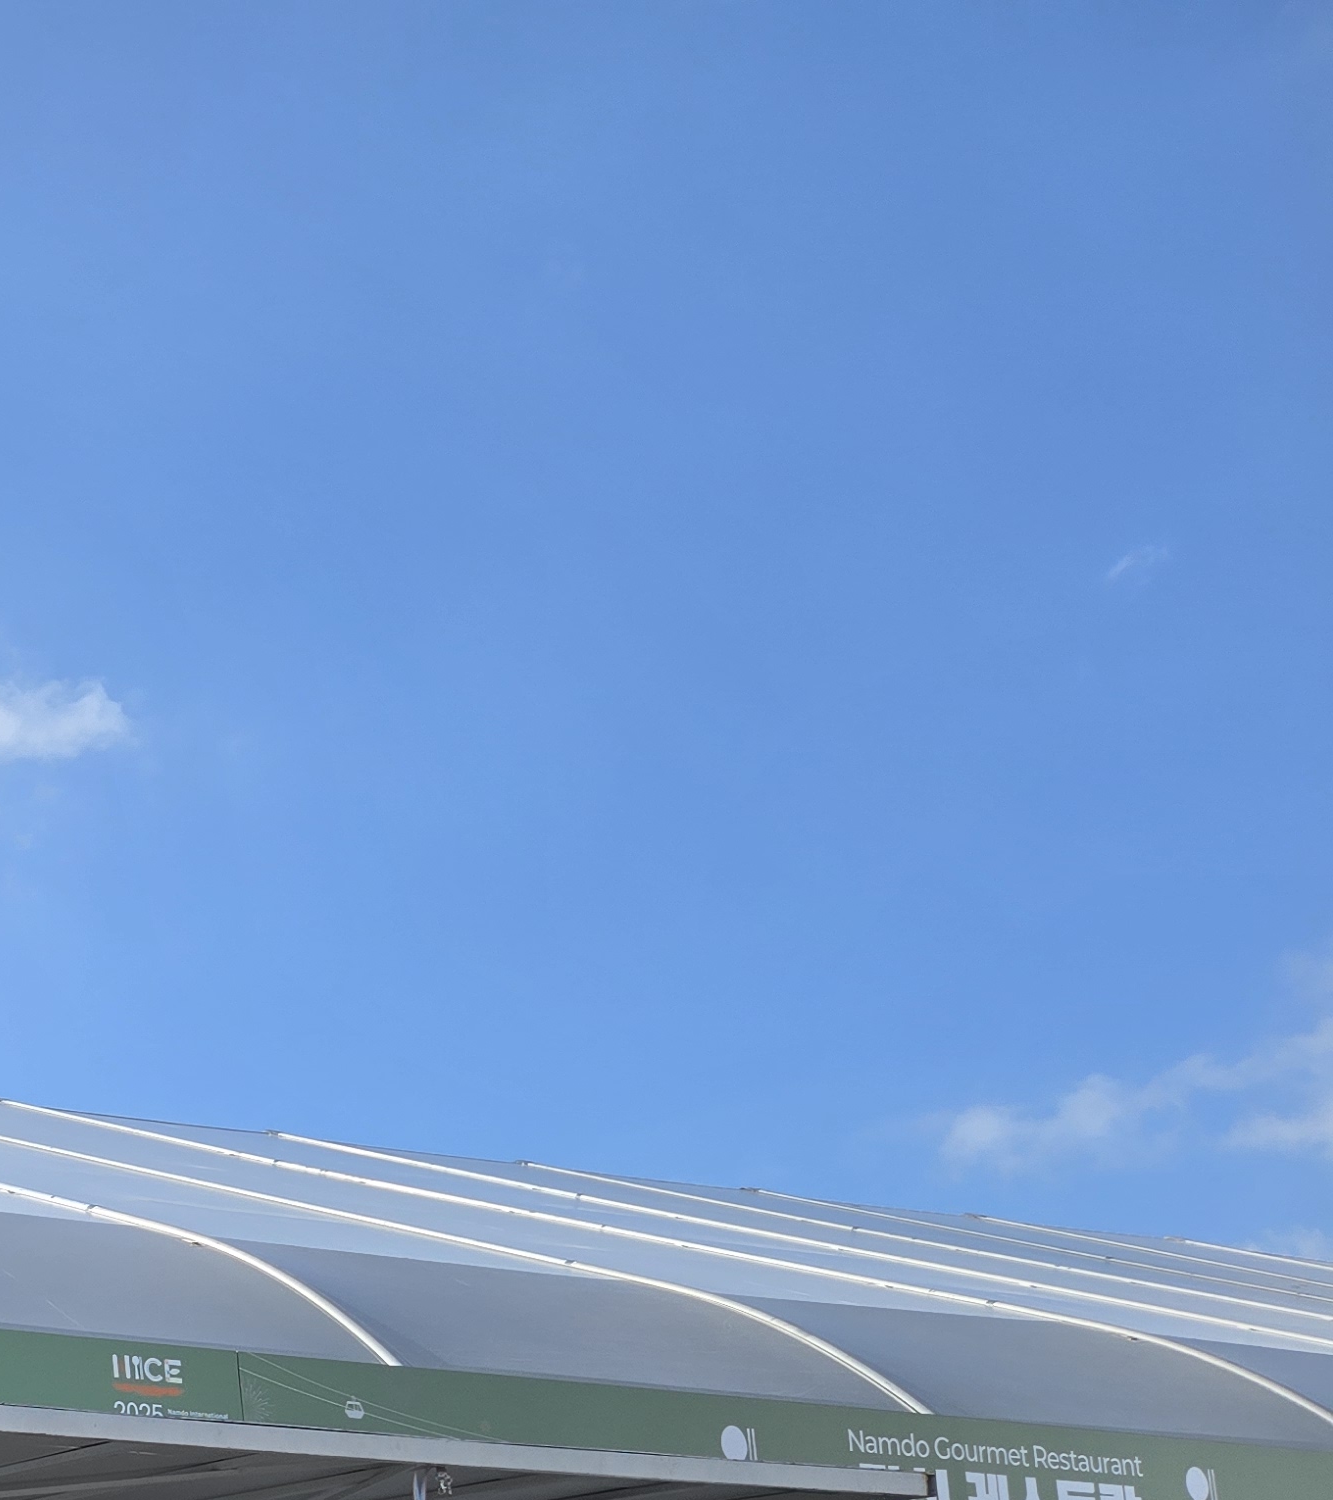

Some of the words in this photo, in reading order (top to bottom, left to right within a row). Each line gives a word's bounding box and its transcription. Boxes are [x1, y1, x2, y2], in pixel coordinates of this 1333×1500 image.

[848, 1428, 930, 1458] Namdo
[934, 1436, 1028, 1468] Gourmet
[1033, 1445, 1144, 1478] Restaurant
